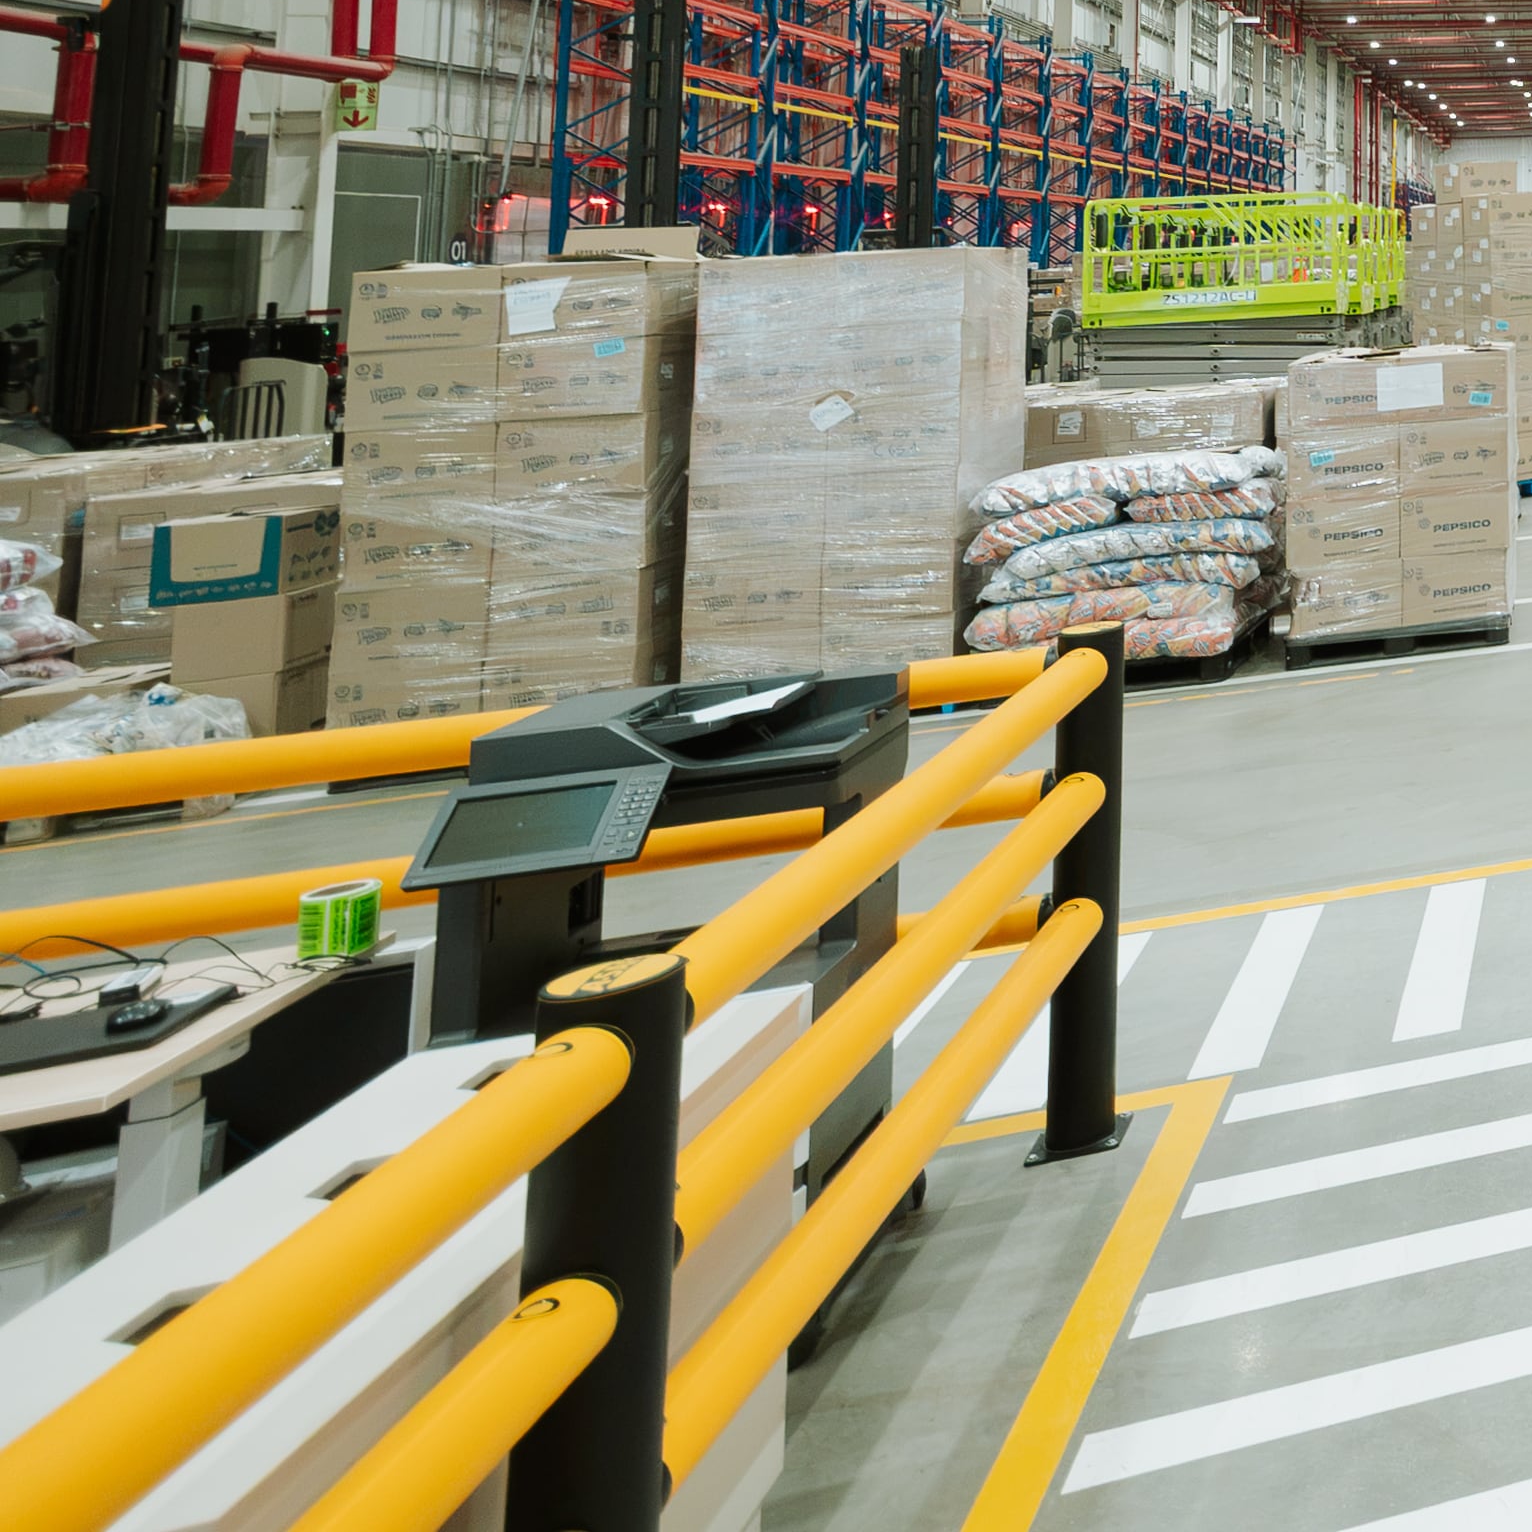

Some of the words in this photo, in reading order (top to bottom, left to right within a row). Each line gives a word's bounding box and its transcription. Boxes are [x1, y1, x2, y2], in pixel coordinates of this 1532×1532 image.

[451, 241, 467, 261] 01
[1324, 394, 1377, 405] PEPSIC
[1324, 462, 1384, 476] PEPSICO
[1432, 519, 1491, 533] PEPSICO
[1432, 583, 1492, 599] PEPSICO
